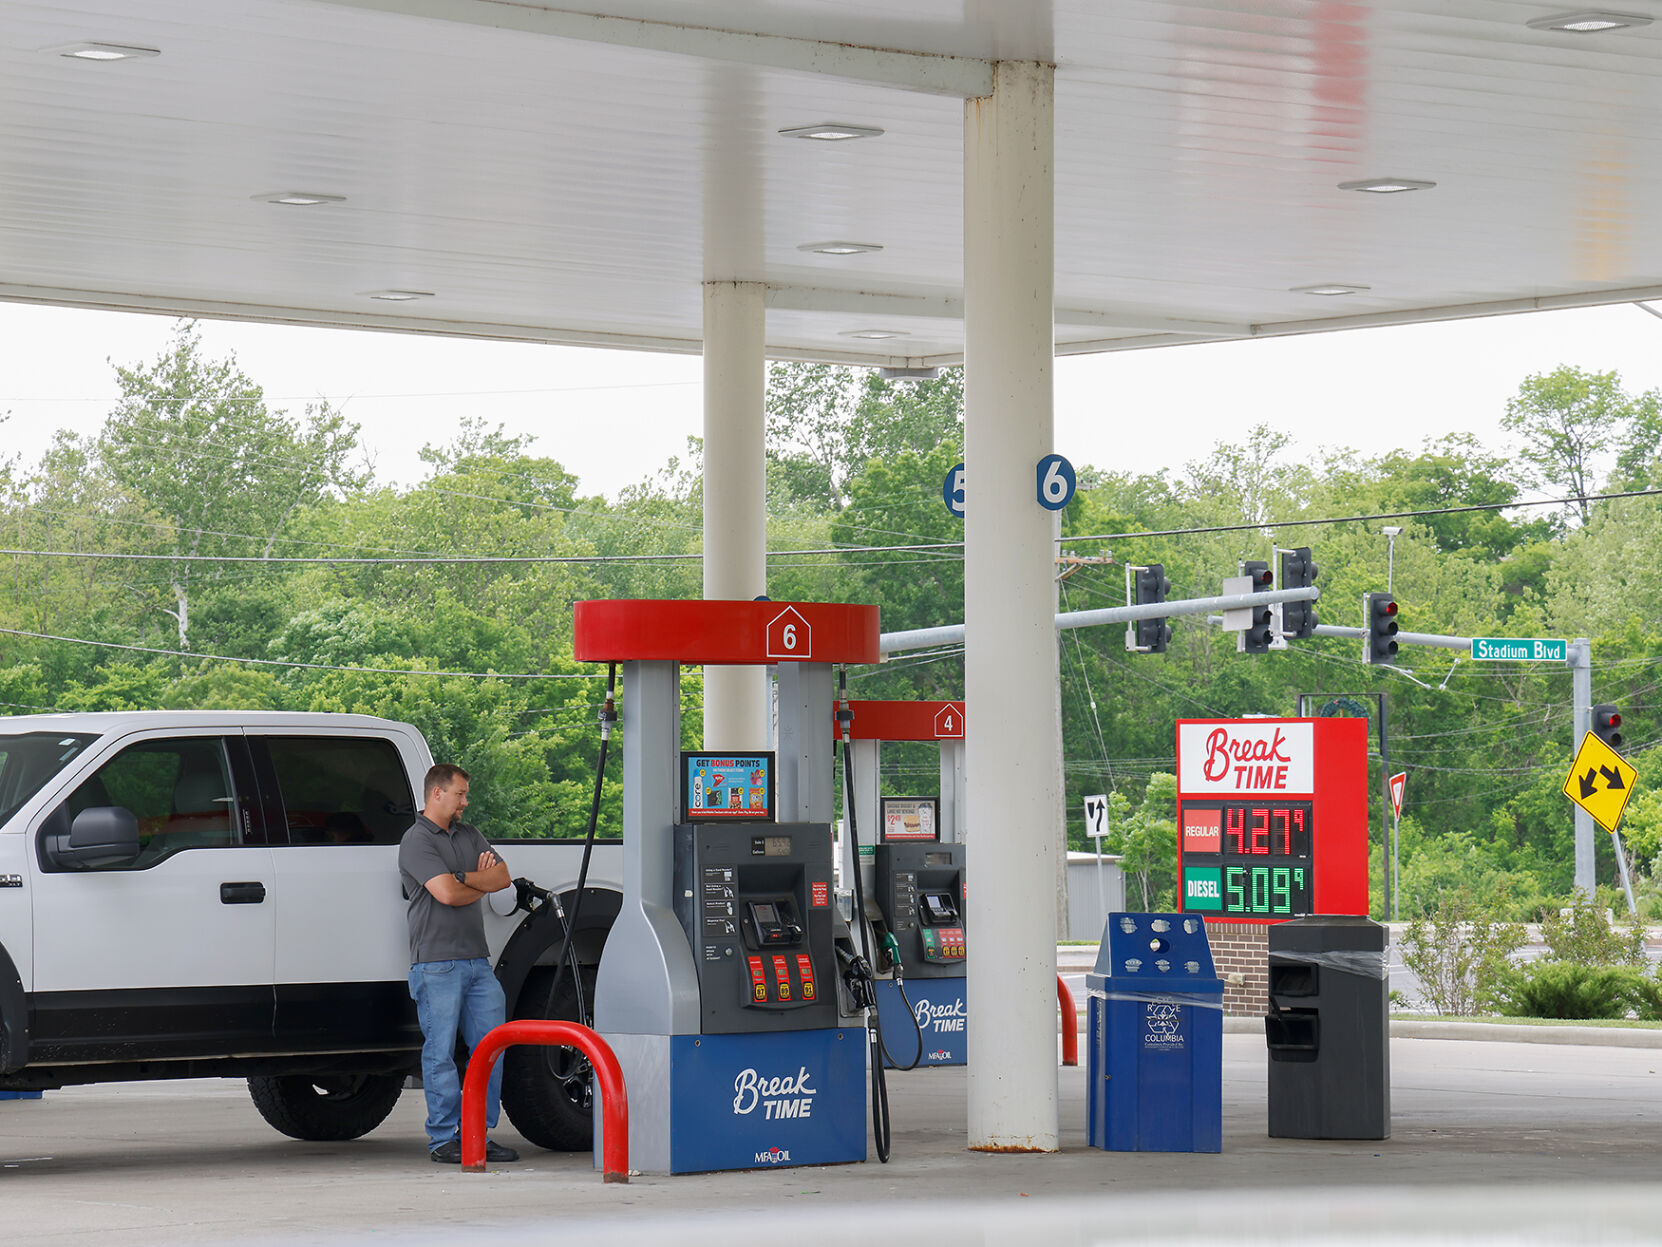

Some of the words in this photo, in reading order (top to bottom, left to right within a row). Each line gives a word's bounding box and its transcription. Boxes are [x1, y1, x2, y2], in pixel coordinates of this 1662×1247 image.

[1043, 460, 1068, 503] 6
[783, 623, 797, 650] 6
[1478, 640, 1528, 658] Stadium
[1534, 641, 1560, 659] Blvd
[944, 715, 953, 731] 4
[696, 759, 710, 767] GET
[711, 759, 734, 767] BONUS
[735, 759, 760, 767] POINTS
[1203, 727, 1292, 782] Break
[1234, 765, 1289, 789] TIME
[1185, 825, 1219, 837] REGULAR
[1187, 880, 1220, 898] DIESEL
[914, 998, 967, 1029] Break
[933, 1018, 965, 1032] TIME
[1144, 1034, 1184, 1042] COLUMBIA
[733, 1066, 817, 1115] Break
[763, 1098, 813, 1120] TIME
[754, 1151, 772, 1163] MFA
[776, 1150, 791, 1162] OIL
